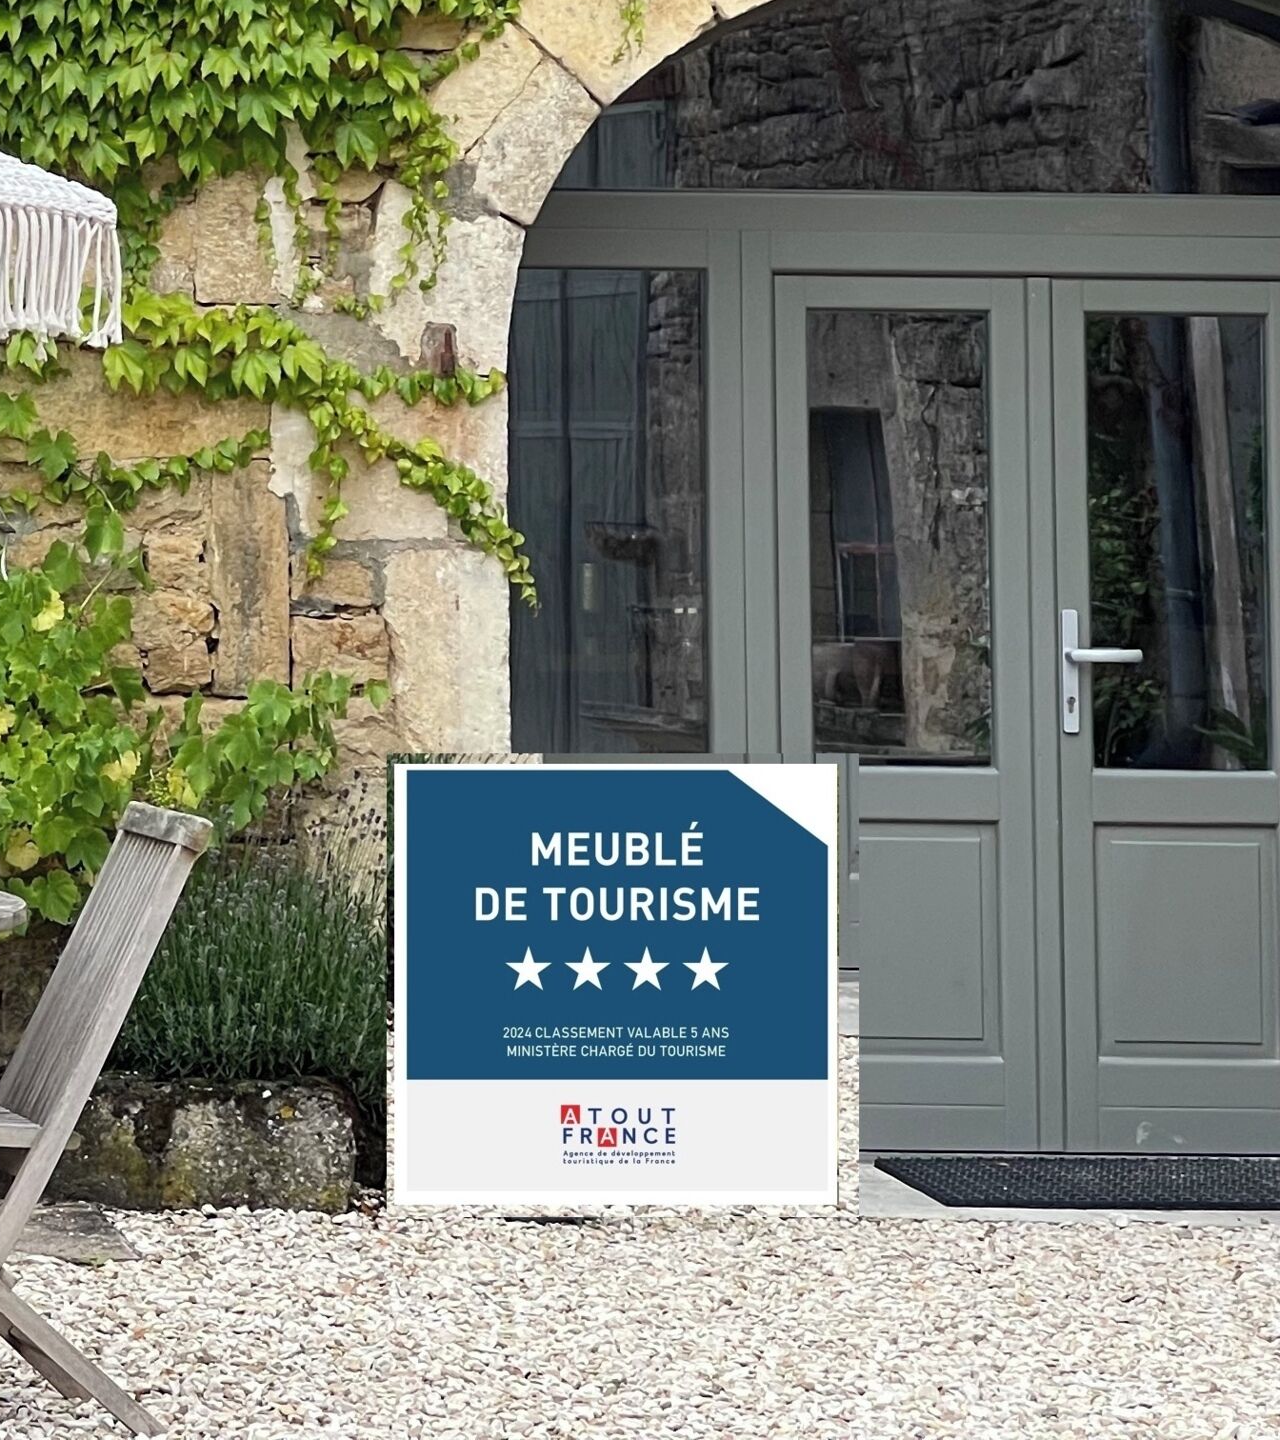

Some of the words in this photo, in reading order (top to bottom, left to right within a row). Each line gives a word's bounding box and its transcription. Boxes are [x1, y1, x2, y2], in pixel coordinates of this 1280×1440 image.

[531, 821, 704, 867] MEUBLÉ
[475, 886, 528, 922] DE
[542, 886, 760, 922] TOURISME
[503, 1026, 532, 1039] 2024
[535, 1026, 624, 1039] CLASSEMENT
[627, 1026, 688, 1039] VALABLE
[690, 1026, 698, 1039] 5
[701, 1026, 730, 1039] ANS
[506, 1042, 577, 1057] MINISTÈRE
[580, 1042, 634, 1057] CHARGÉ
[638, 1044, 656, 1057] DU
[660, 1044, 727, 1057] TOURISME
[562, 1107, 676, 1125] ATOUT
[562, 1127, 676, 1145] FRANCE
[562, 1157, 615, 1166] touristique
[618, 1157, 629, 1165] de
[632, 1157, 642, 1165] la
[645, 1157, 676, 1165] France
[563, 1150, 594, 1159] Agence
[597, 1149, 608, 1157] de
[610, 1149, 676, 1159] développement
